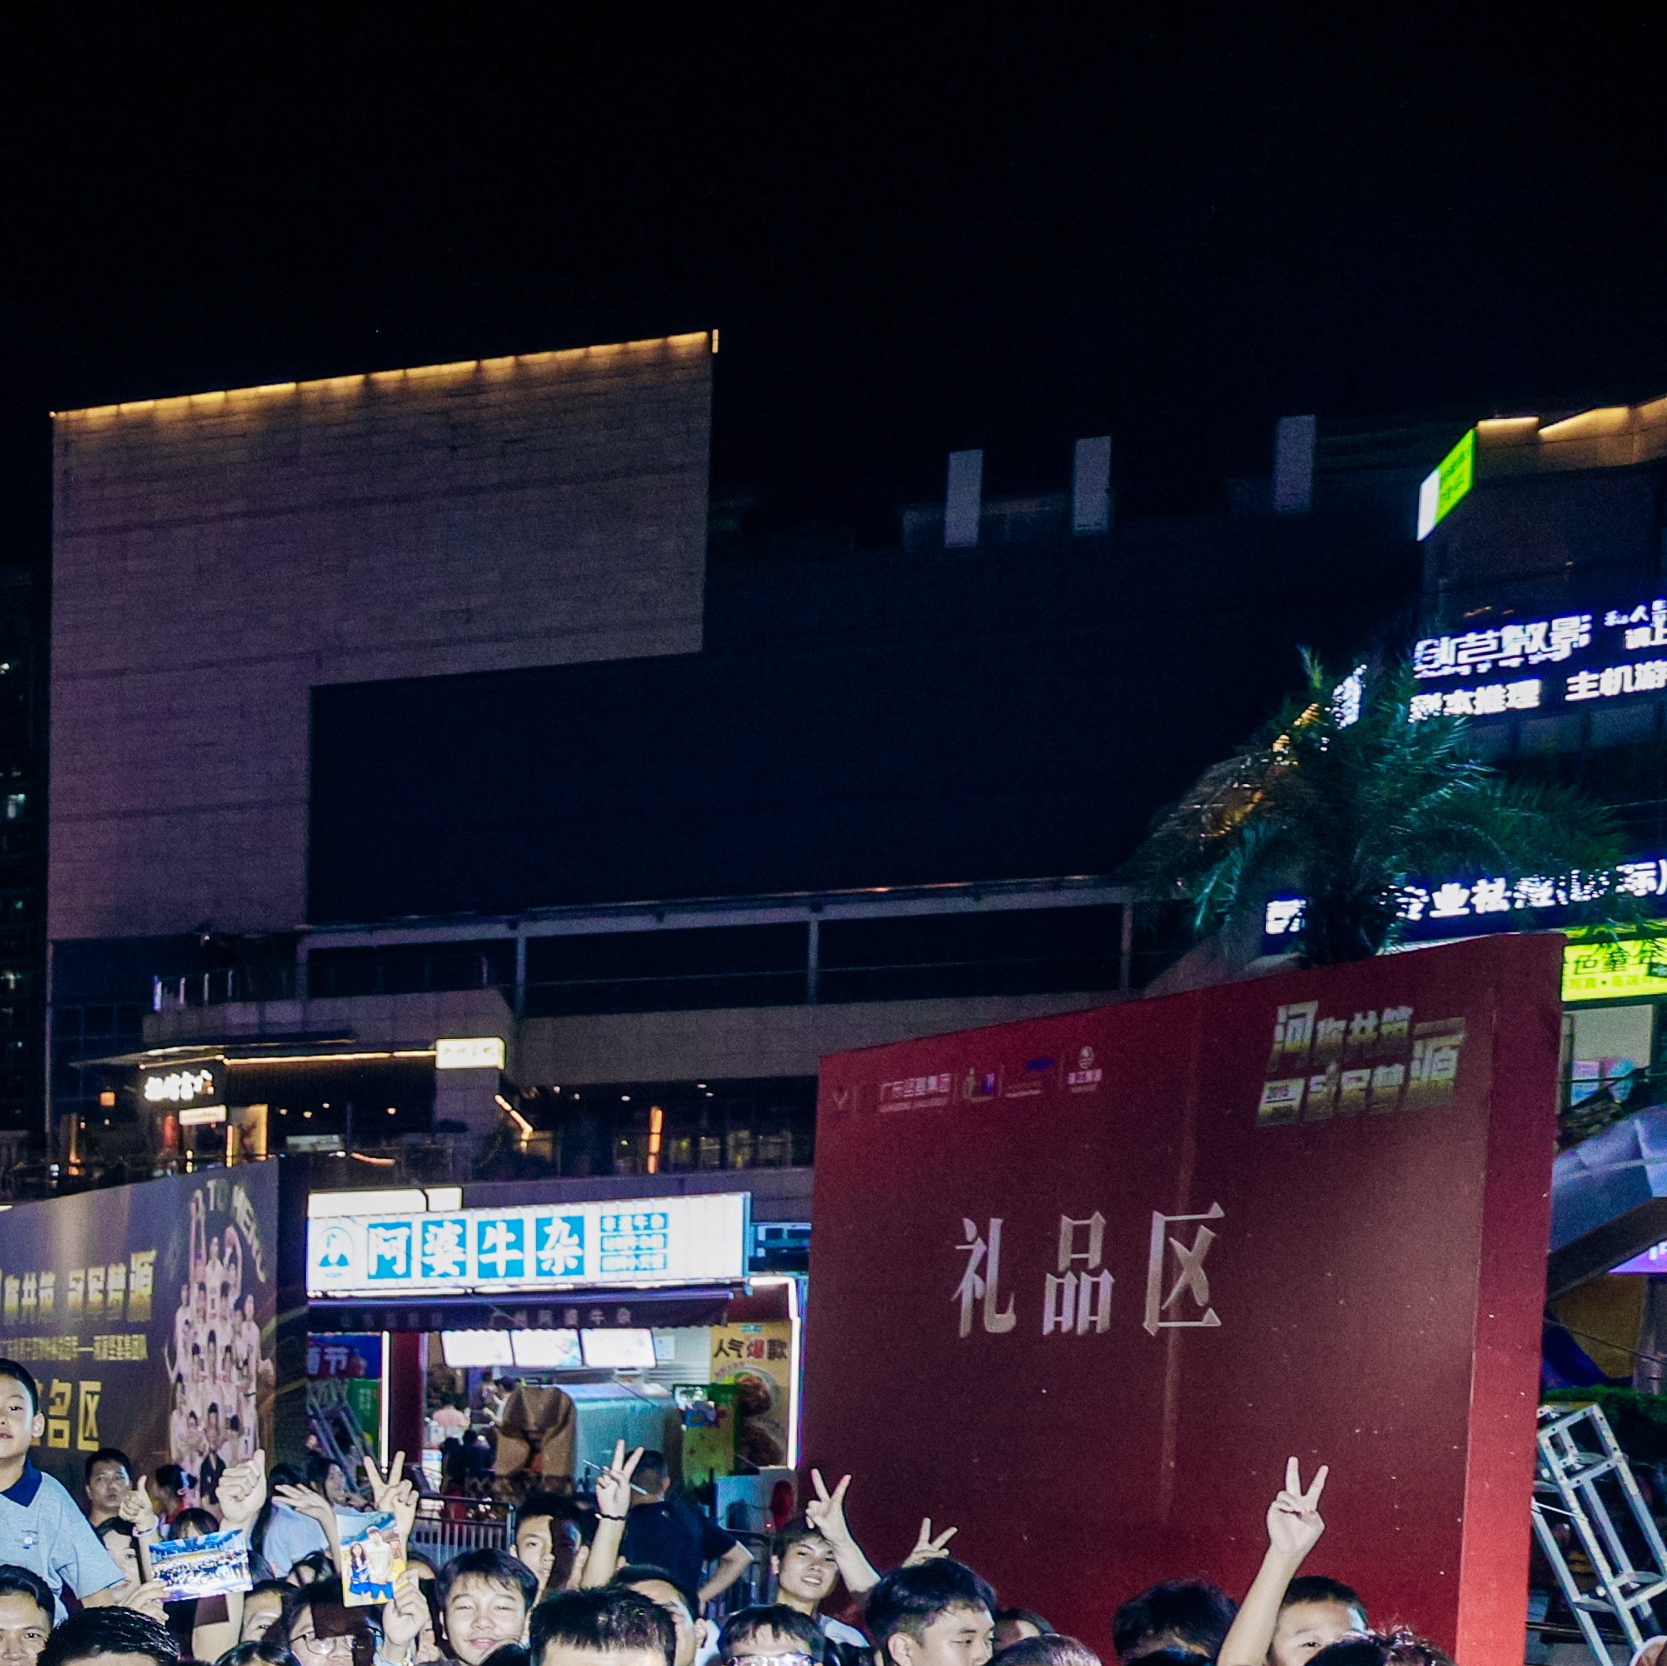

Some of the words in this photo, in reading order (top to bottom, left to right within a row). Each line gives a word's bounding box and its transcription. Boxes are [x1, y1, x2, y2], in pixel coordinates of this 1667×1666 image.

[367, 1214, 585, 1280] 阿婆牛杂
[952, 1201, 1226, 1338] 礼品区
[33, 1380, 102, 1451] 名区
